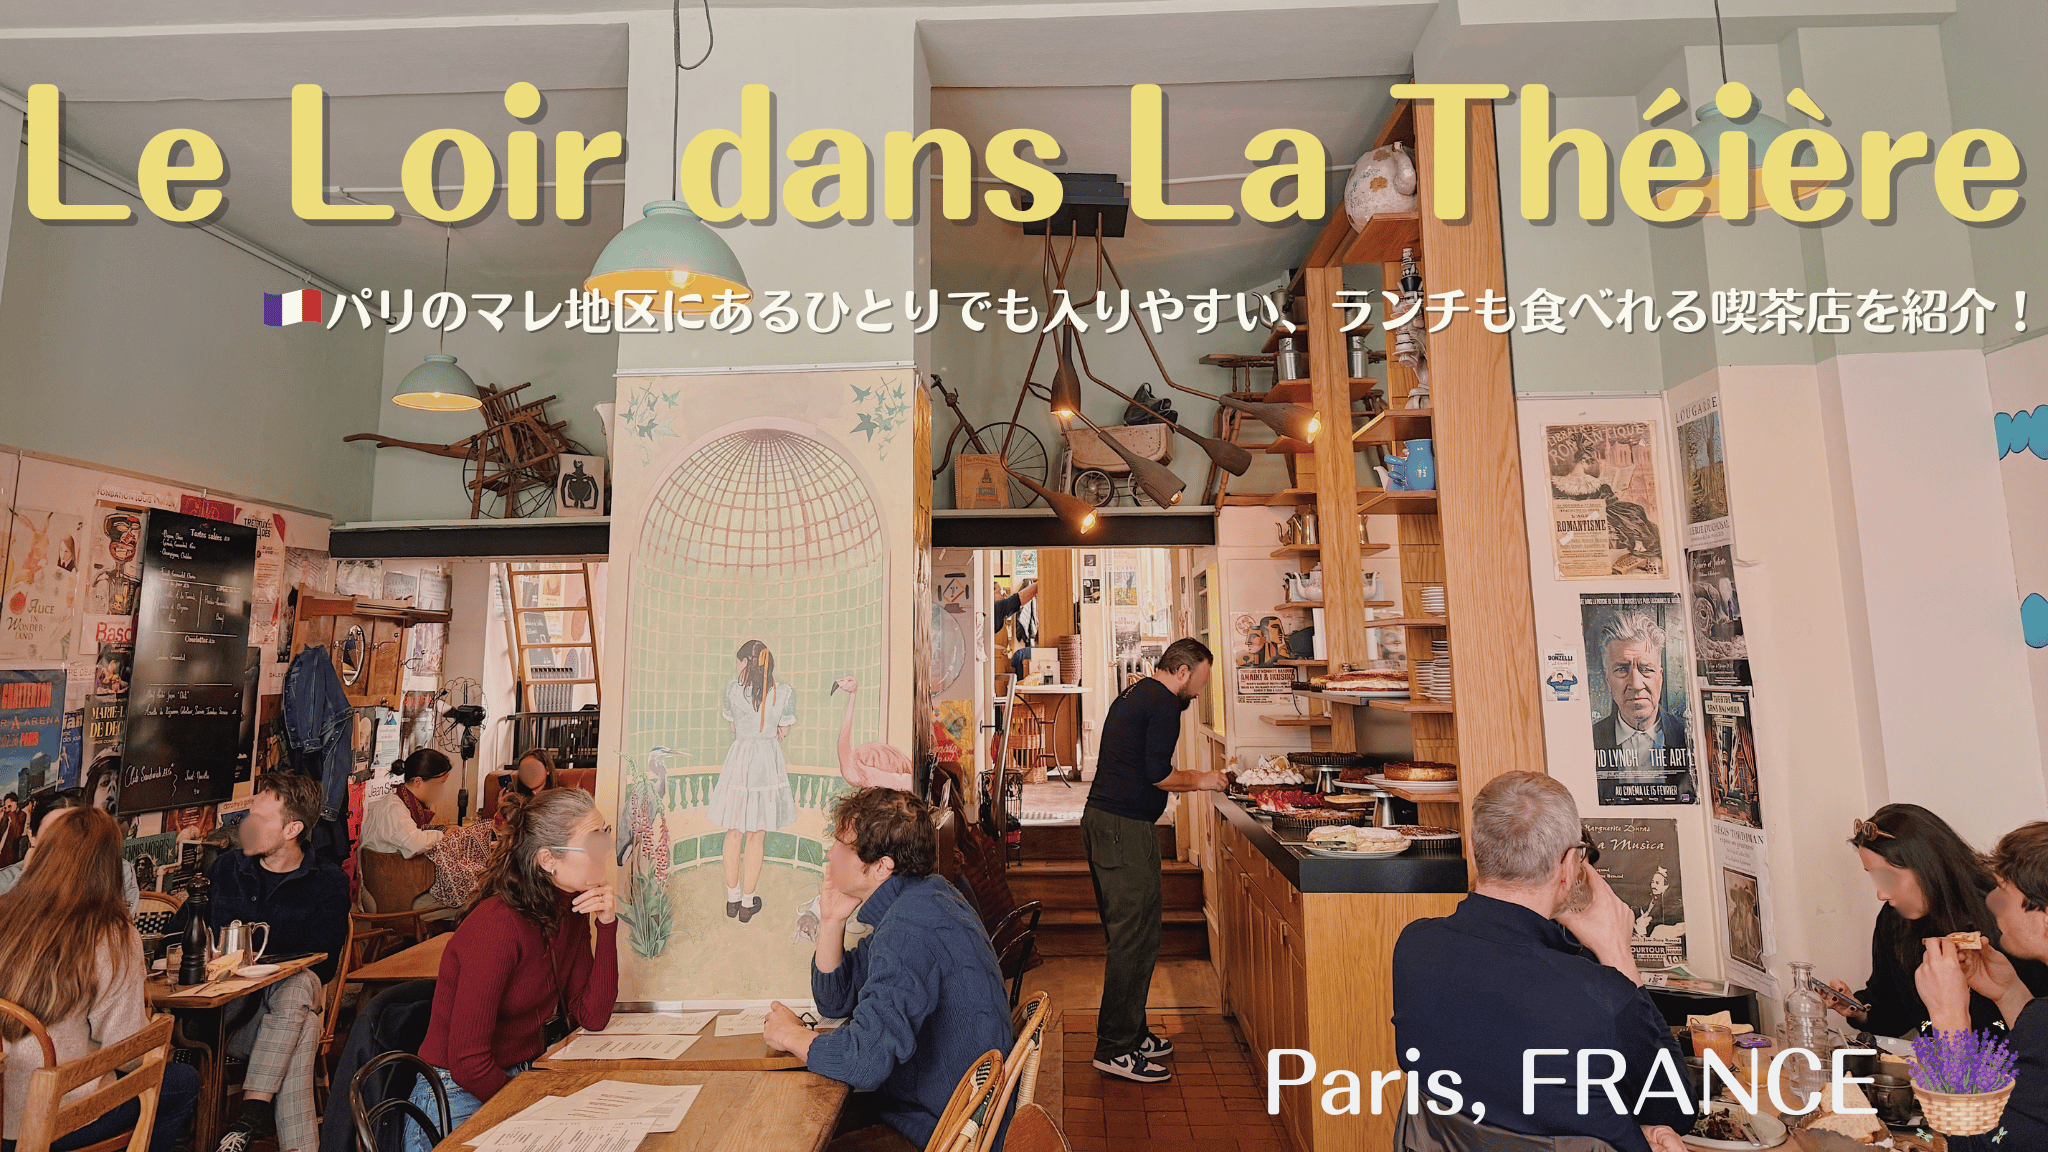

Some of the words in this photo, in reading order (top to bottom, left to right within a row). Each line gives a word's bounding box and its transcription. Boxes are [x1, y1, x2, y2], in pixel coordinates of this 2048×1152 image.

[1556, 519, 1606, 532] ROMANTISME
[27, 598, 55, 614] ALICE
[24, 716, 60, 726] ARENA
[90, 722, 104, 738] DE
[1608, 748, 1639, 767] LYNCH
[1648, 748, 1668, 767] THE
[1669, 748, 1687, 767] ART
[368, 785, 384, 798] Jean
[1622, 784, 1643, 796] CINÉMA
[1643, 785, 1650, 796] LE
[1657, 784, 1678, 796] FÉVRIER
[1623, 824, 1651, 833] Duras
[1610, 838, 1665, 851] Musica
[1630, 946, 1666, 954] OURTOUR
